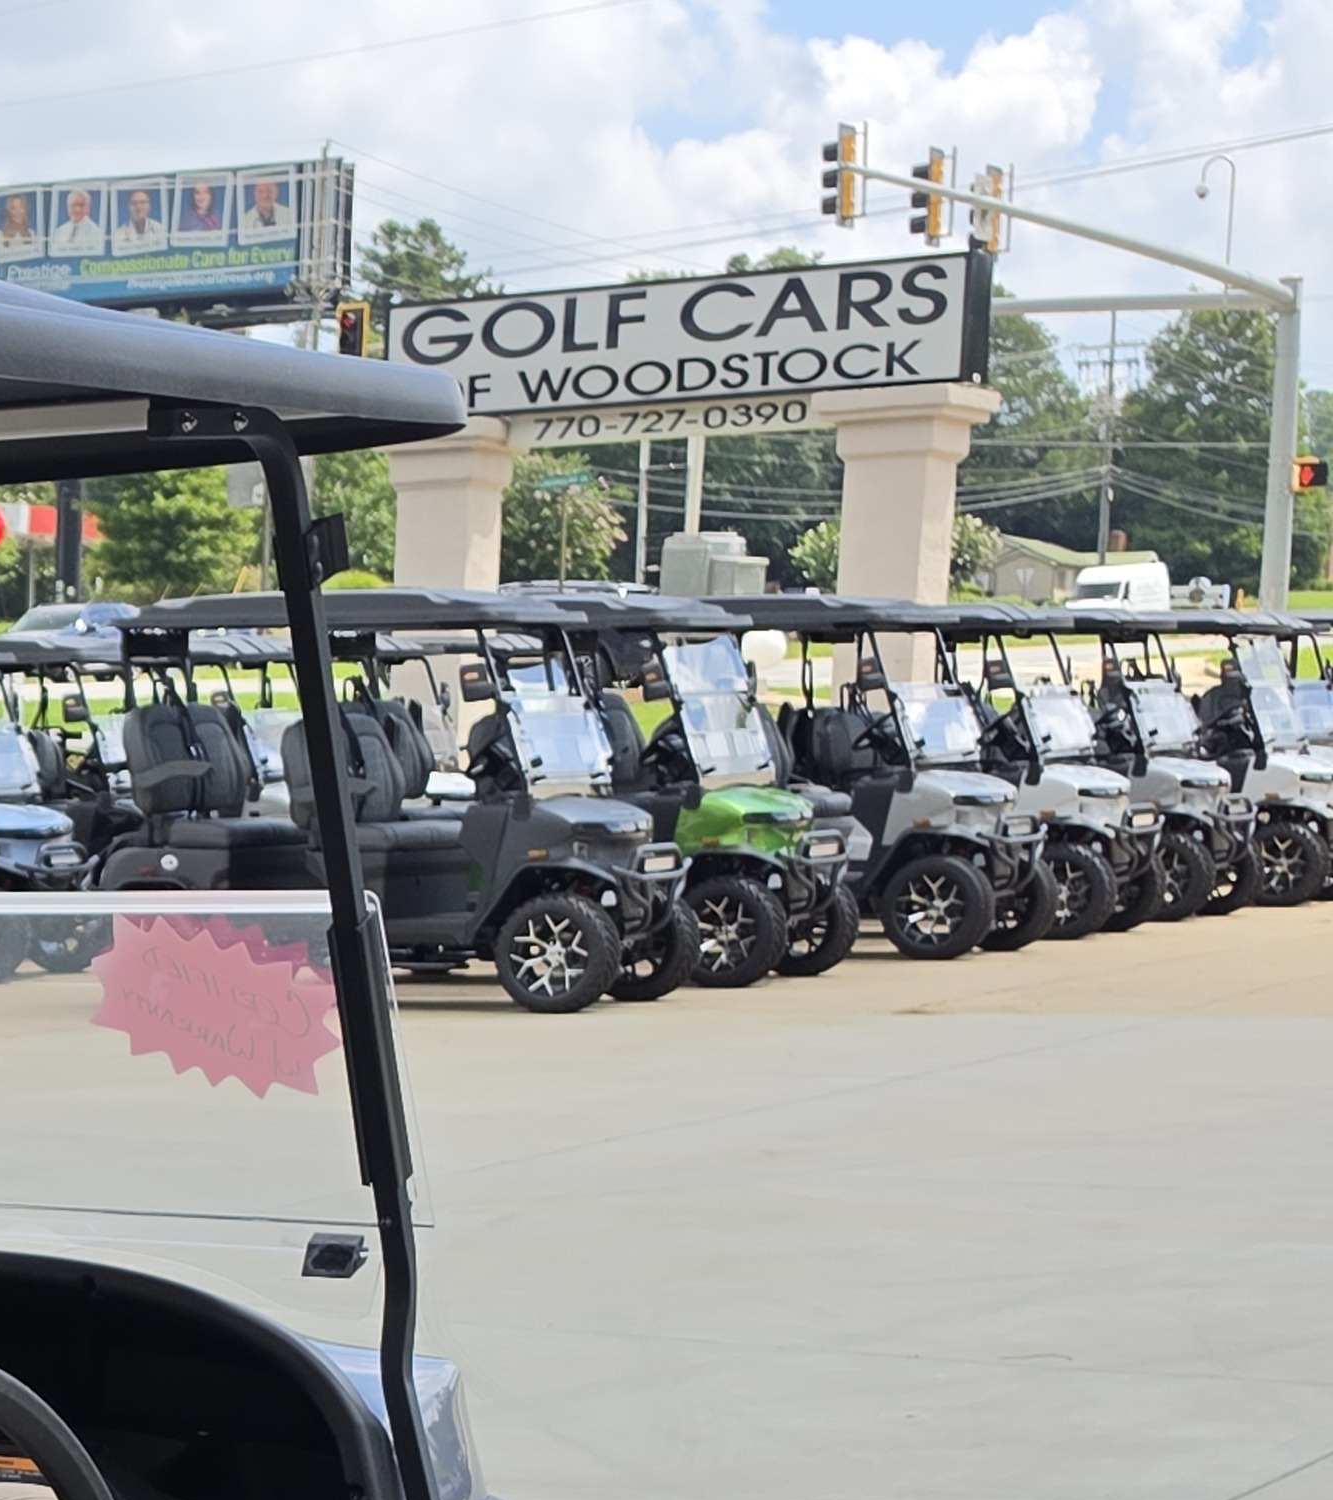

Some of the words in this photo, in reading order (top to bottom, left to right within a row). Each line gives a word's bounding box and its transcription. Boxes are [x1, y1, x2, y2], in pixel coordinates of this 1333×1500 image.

[402, 289, 648, 366] GOLF
[679, 263, 949, 342] CARS
[517, 338, 923, 404] WOODSTOCK
[532, 399, 808, 441] 770-727-0390
